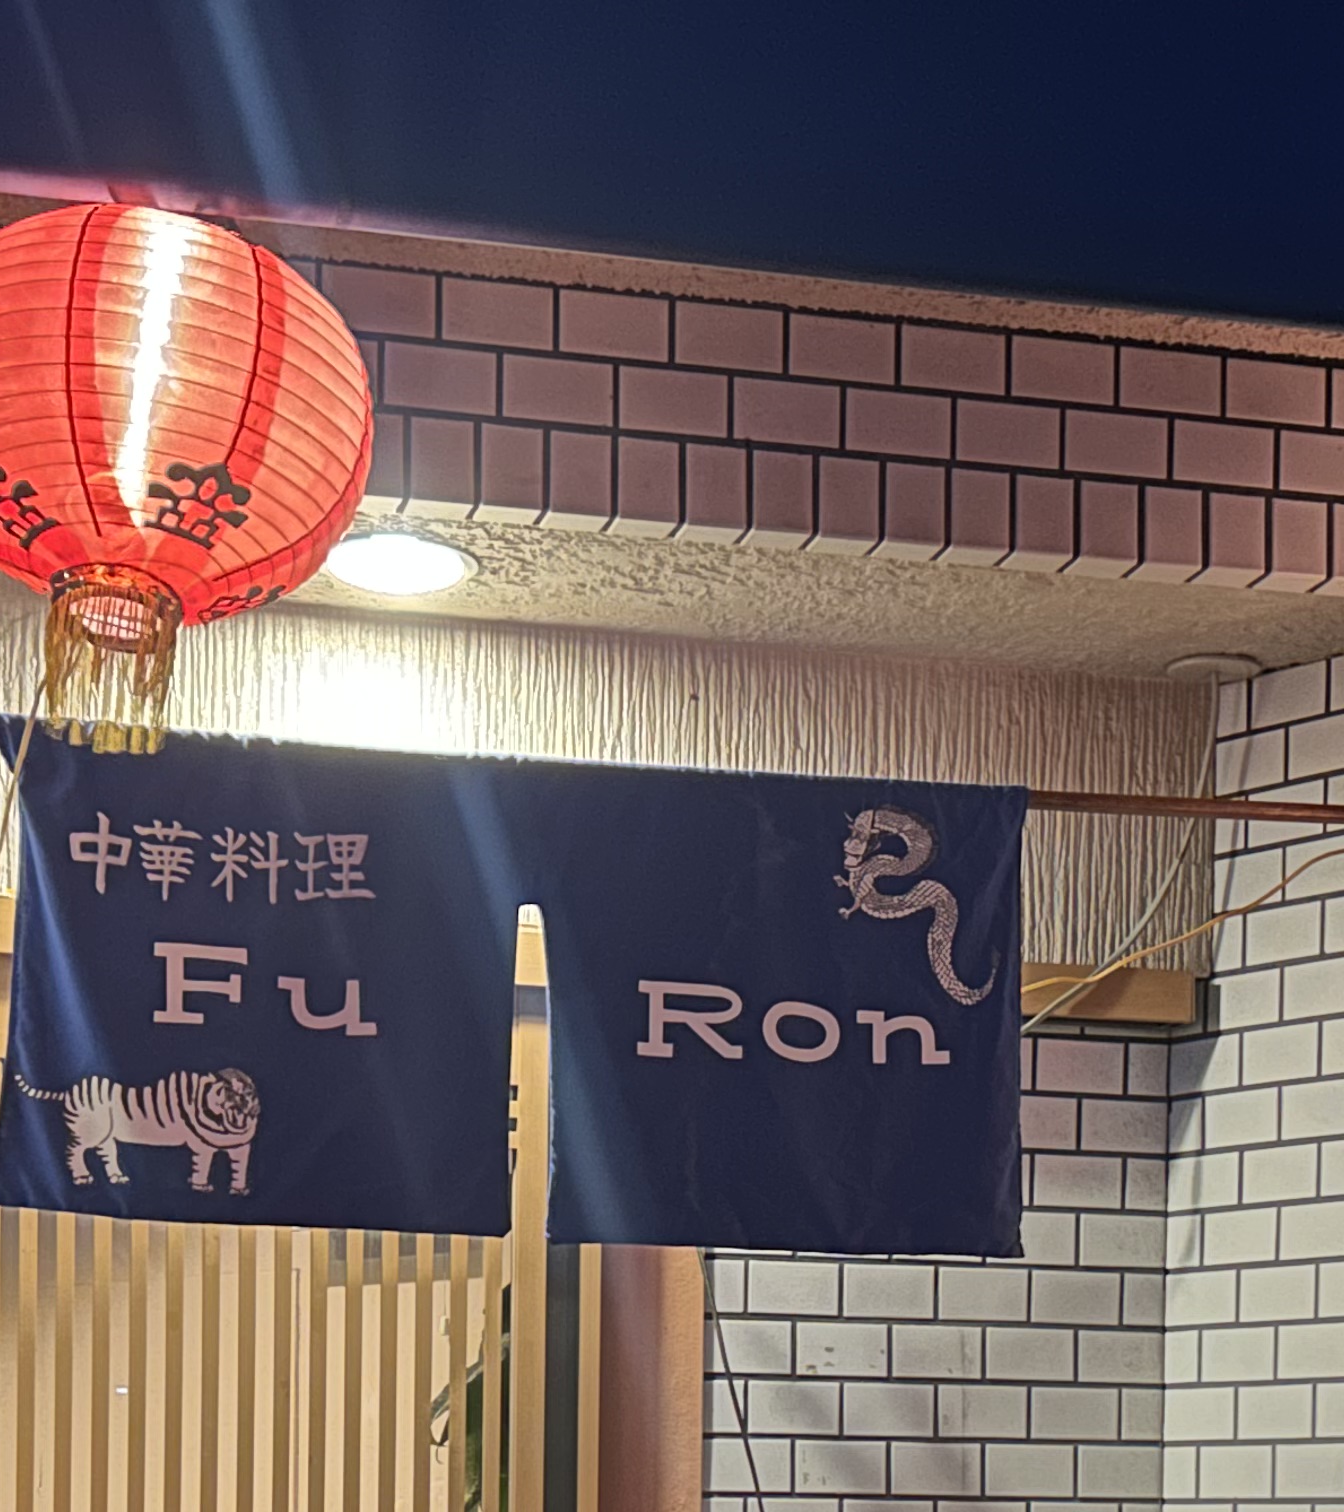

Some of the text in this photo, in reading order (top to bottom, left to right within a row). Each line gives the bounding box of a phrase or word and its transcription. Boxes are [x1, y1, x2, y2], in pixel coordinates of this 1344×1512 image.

[68, 810, 376, 905] 中華料理
[152, 941, 951, 1066] Fu Ron
